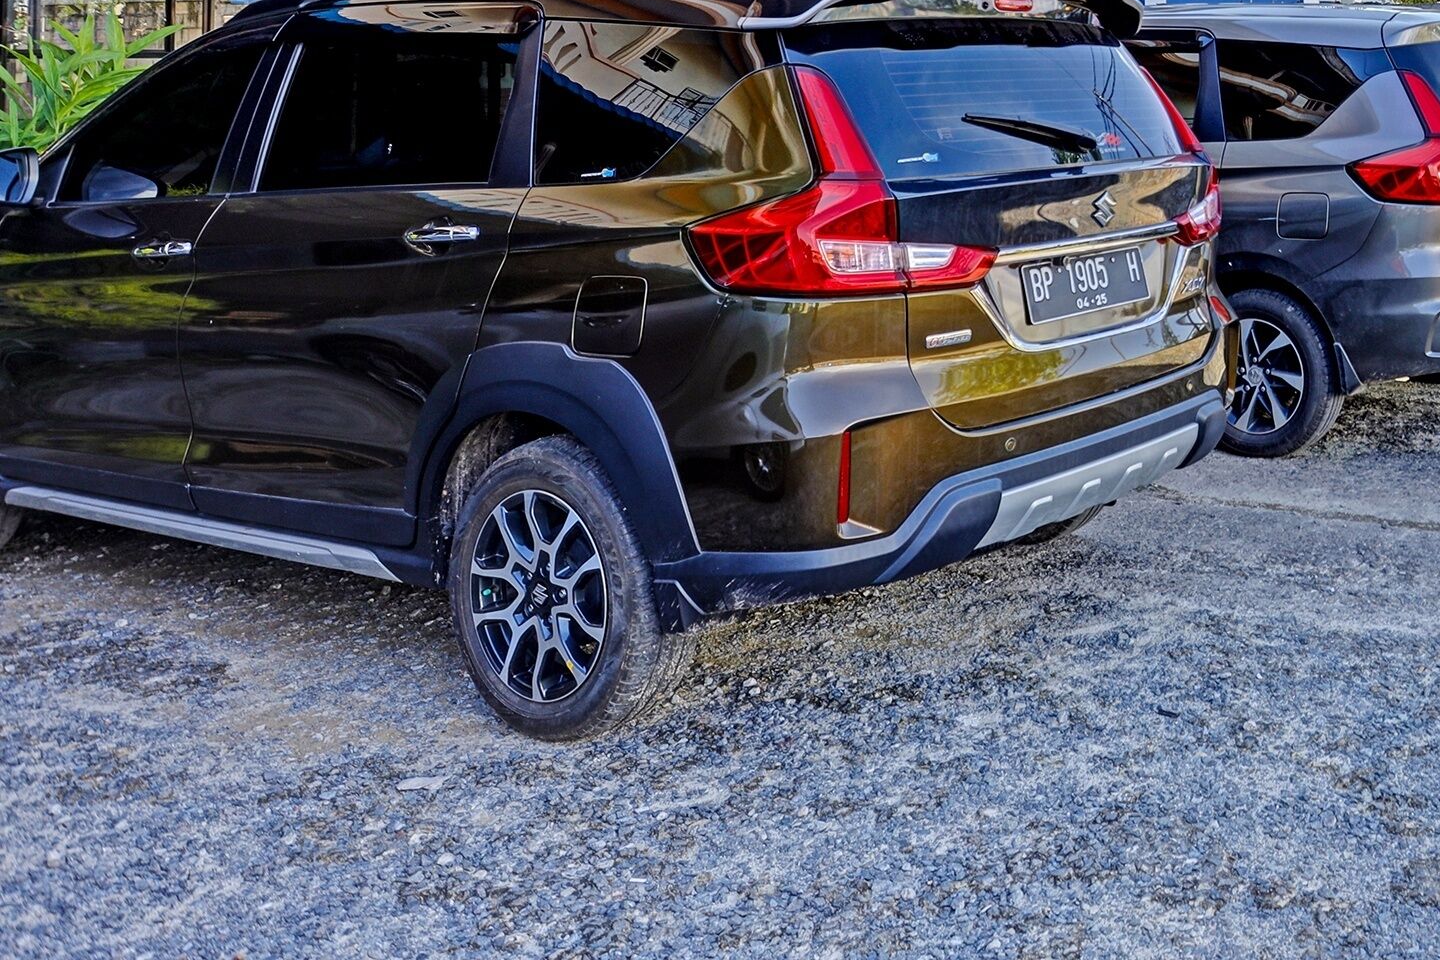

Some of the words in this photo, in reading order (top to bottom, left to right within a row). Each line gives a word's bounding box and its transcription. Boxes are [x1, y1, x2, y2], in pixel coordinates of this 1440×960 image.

[1029, 269, 1053, 302] BP
[1065, 256, 1110, 294] 1905
[1125, 252, 1141, 282] H
